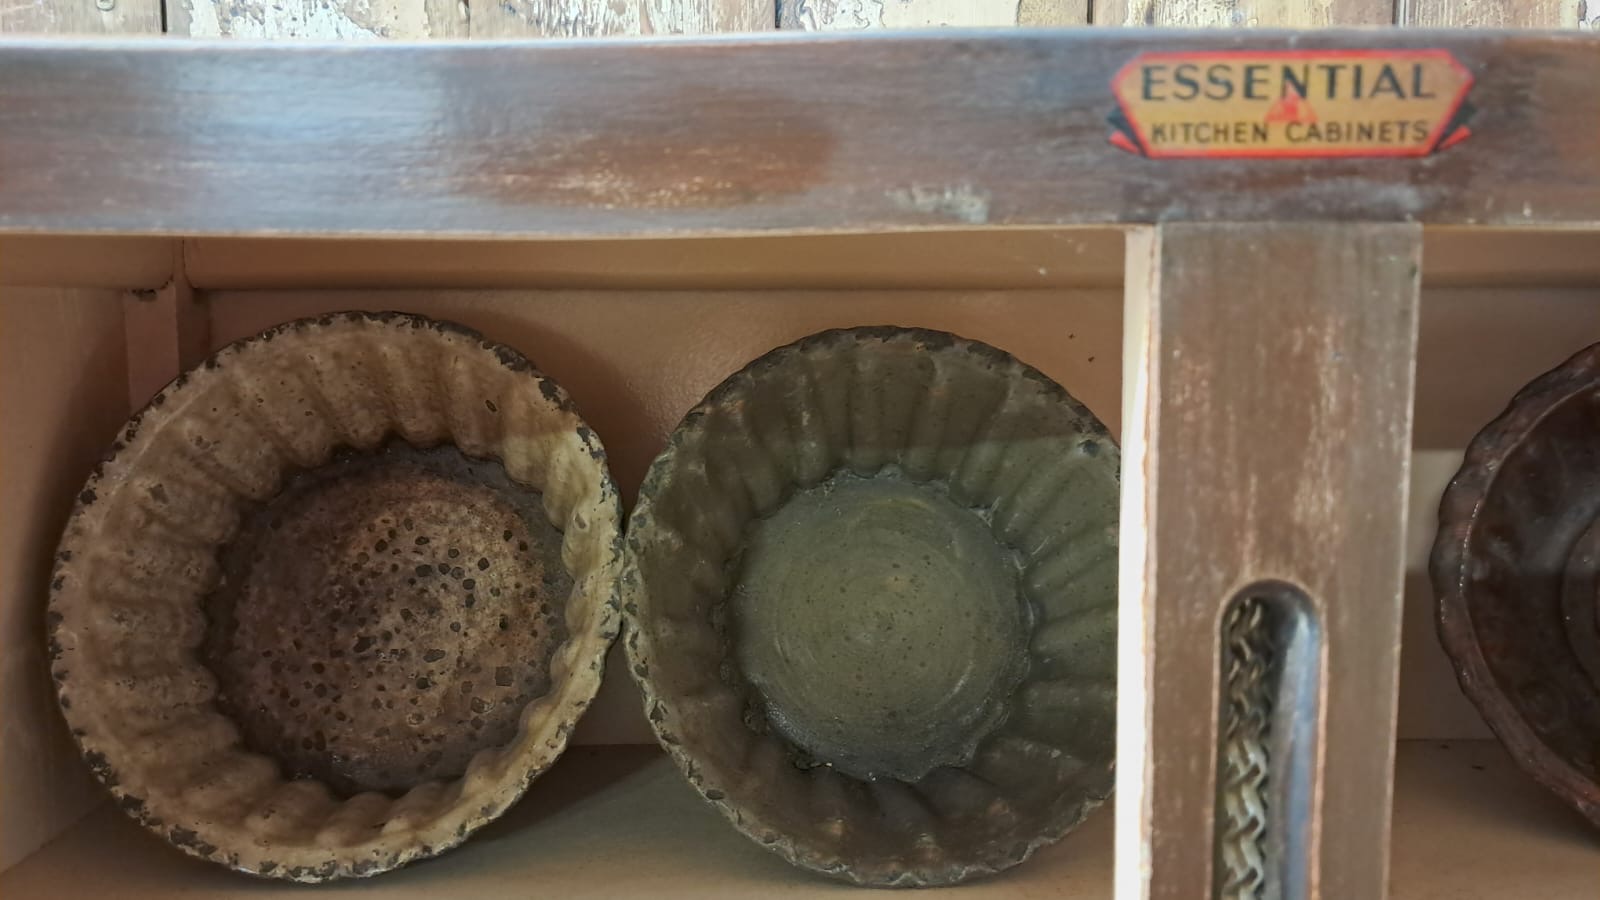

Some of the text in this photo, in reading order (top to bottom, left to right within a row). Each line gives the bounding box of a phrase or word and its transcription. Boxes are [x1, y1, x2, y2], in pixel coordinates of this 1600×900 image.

[1141, 63, 1437, 101] ESSENTIAL
[1151, 120, 1429, 143] KITCHEN CABINETS
